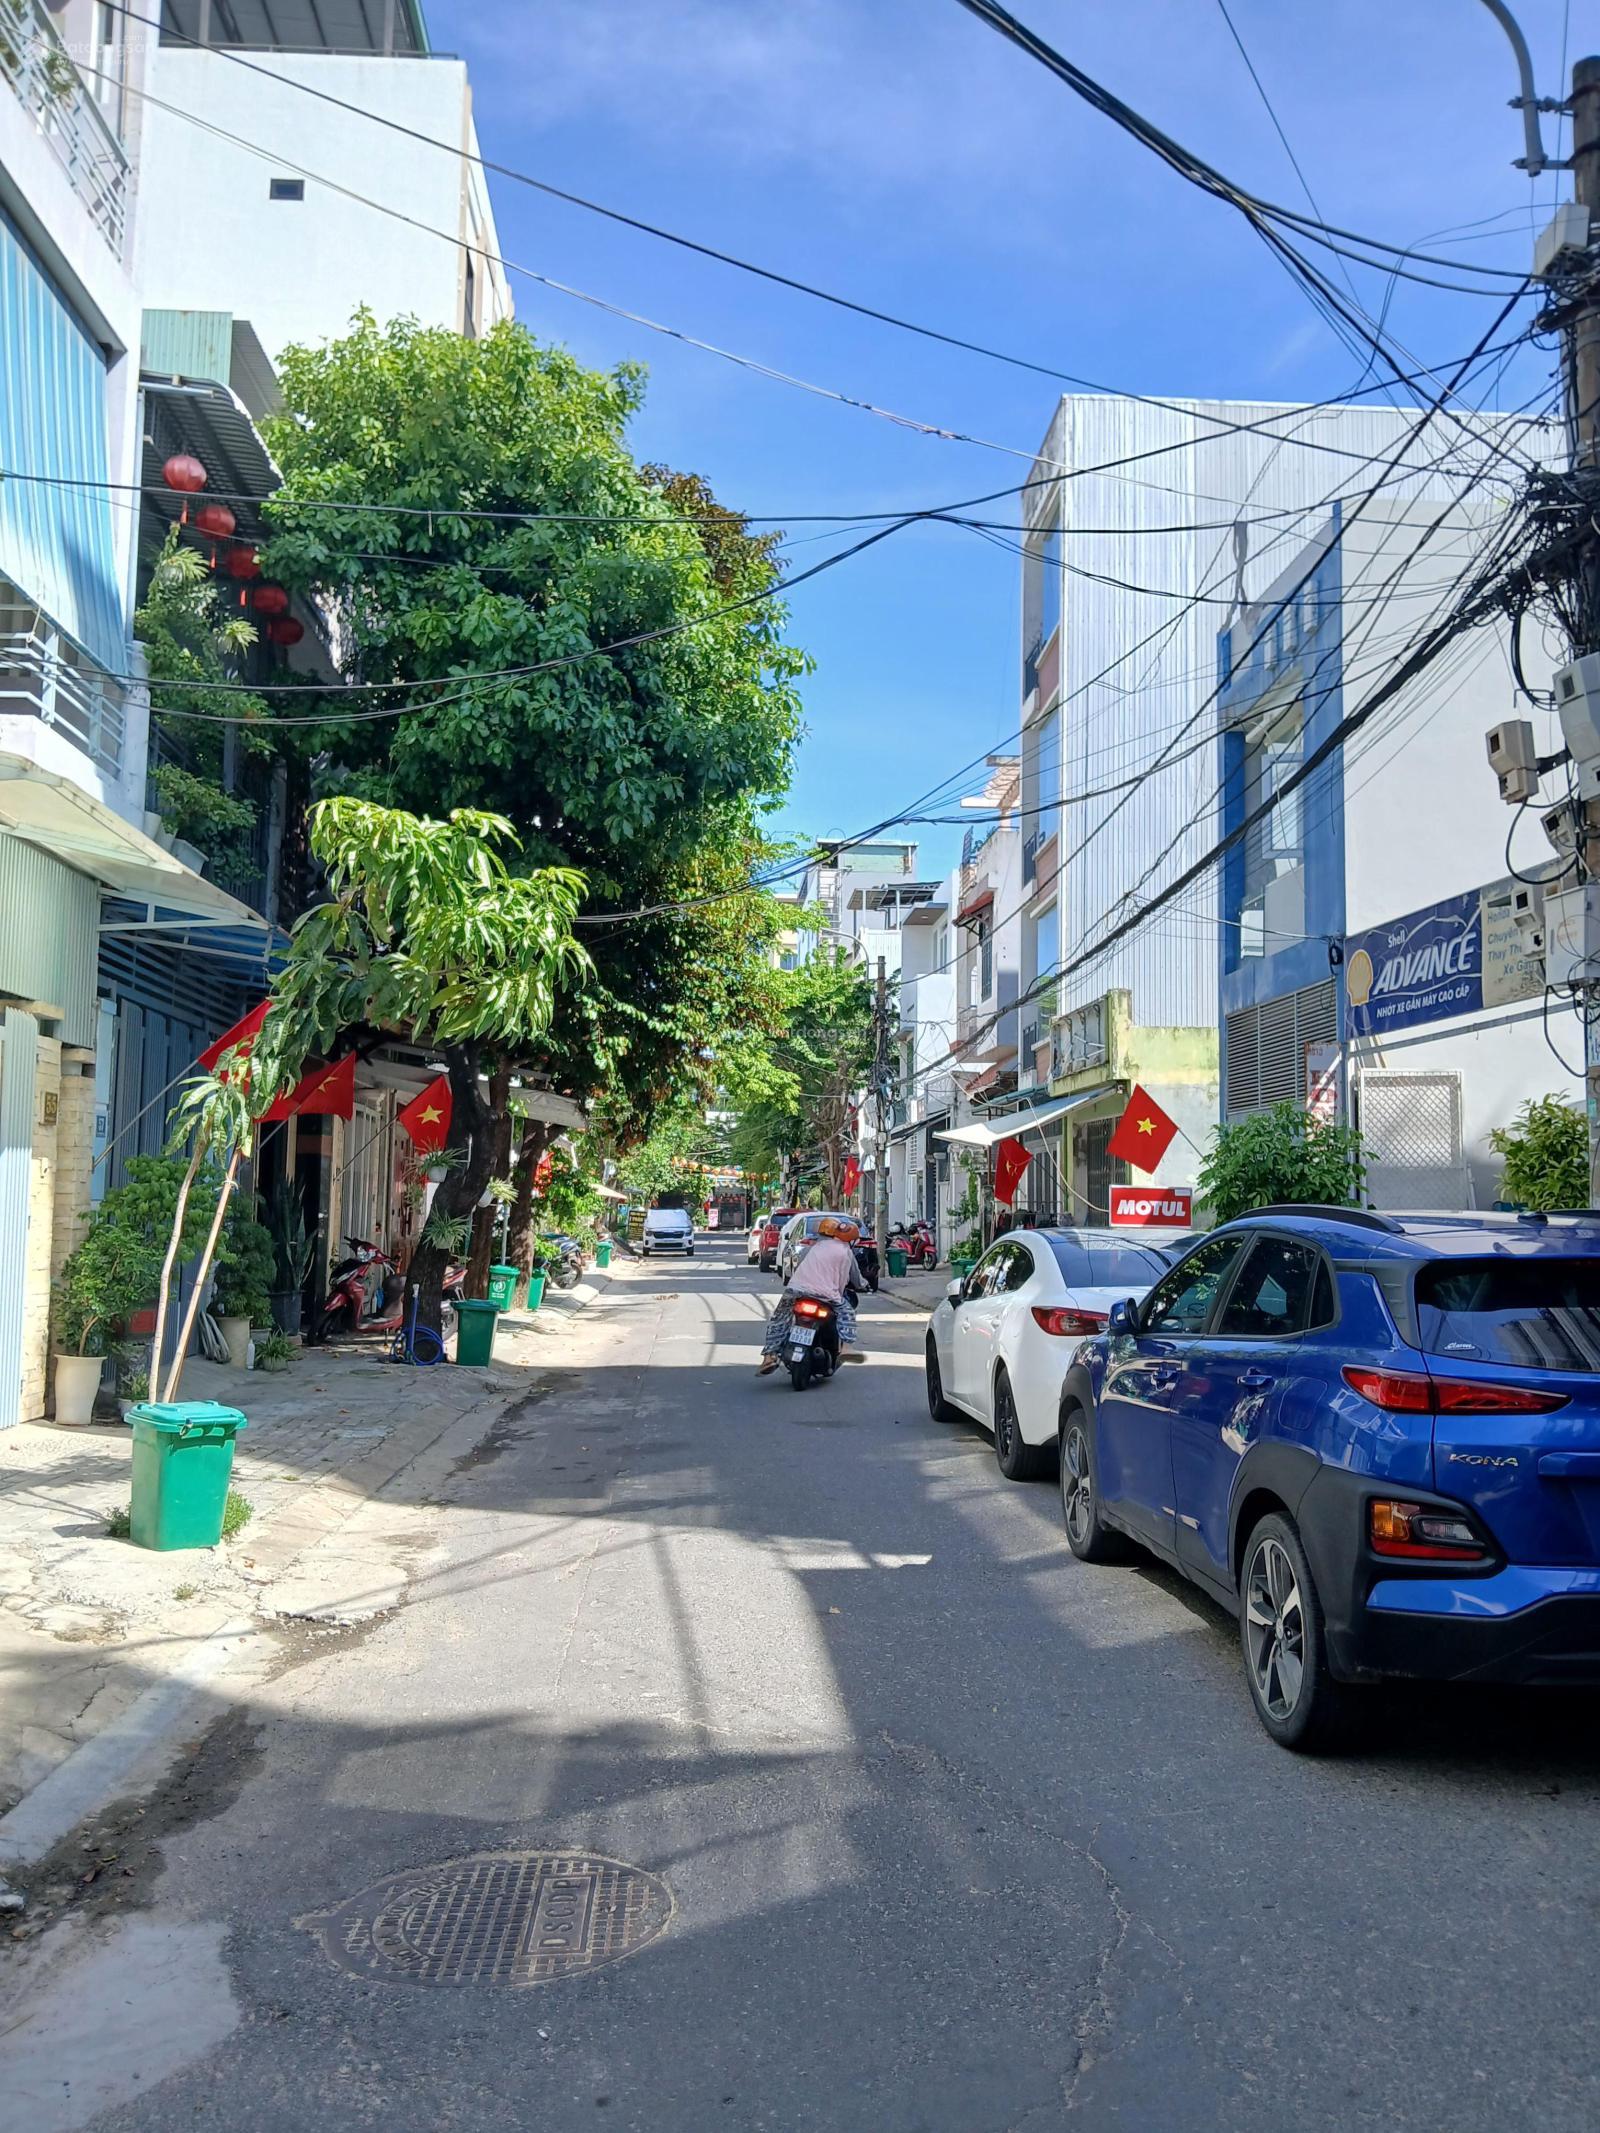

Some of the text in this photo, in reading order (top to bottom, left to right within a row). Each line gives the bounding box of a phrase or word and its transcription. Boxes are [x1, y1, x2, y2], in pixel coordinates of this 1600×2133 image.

[1388, 929, 1405, 948] Shell
[1372, 931, 1477, 996] ADVANCE
[1396, 1002, 1406, 1015] XE
[1438, 989, 1454, 1004] CAO
[46, 1101, 57, 1114] 55
[1116, 1199, 1187, 1217] MOTUL
[1449, 1453, 1519, 1467] KONA
